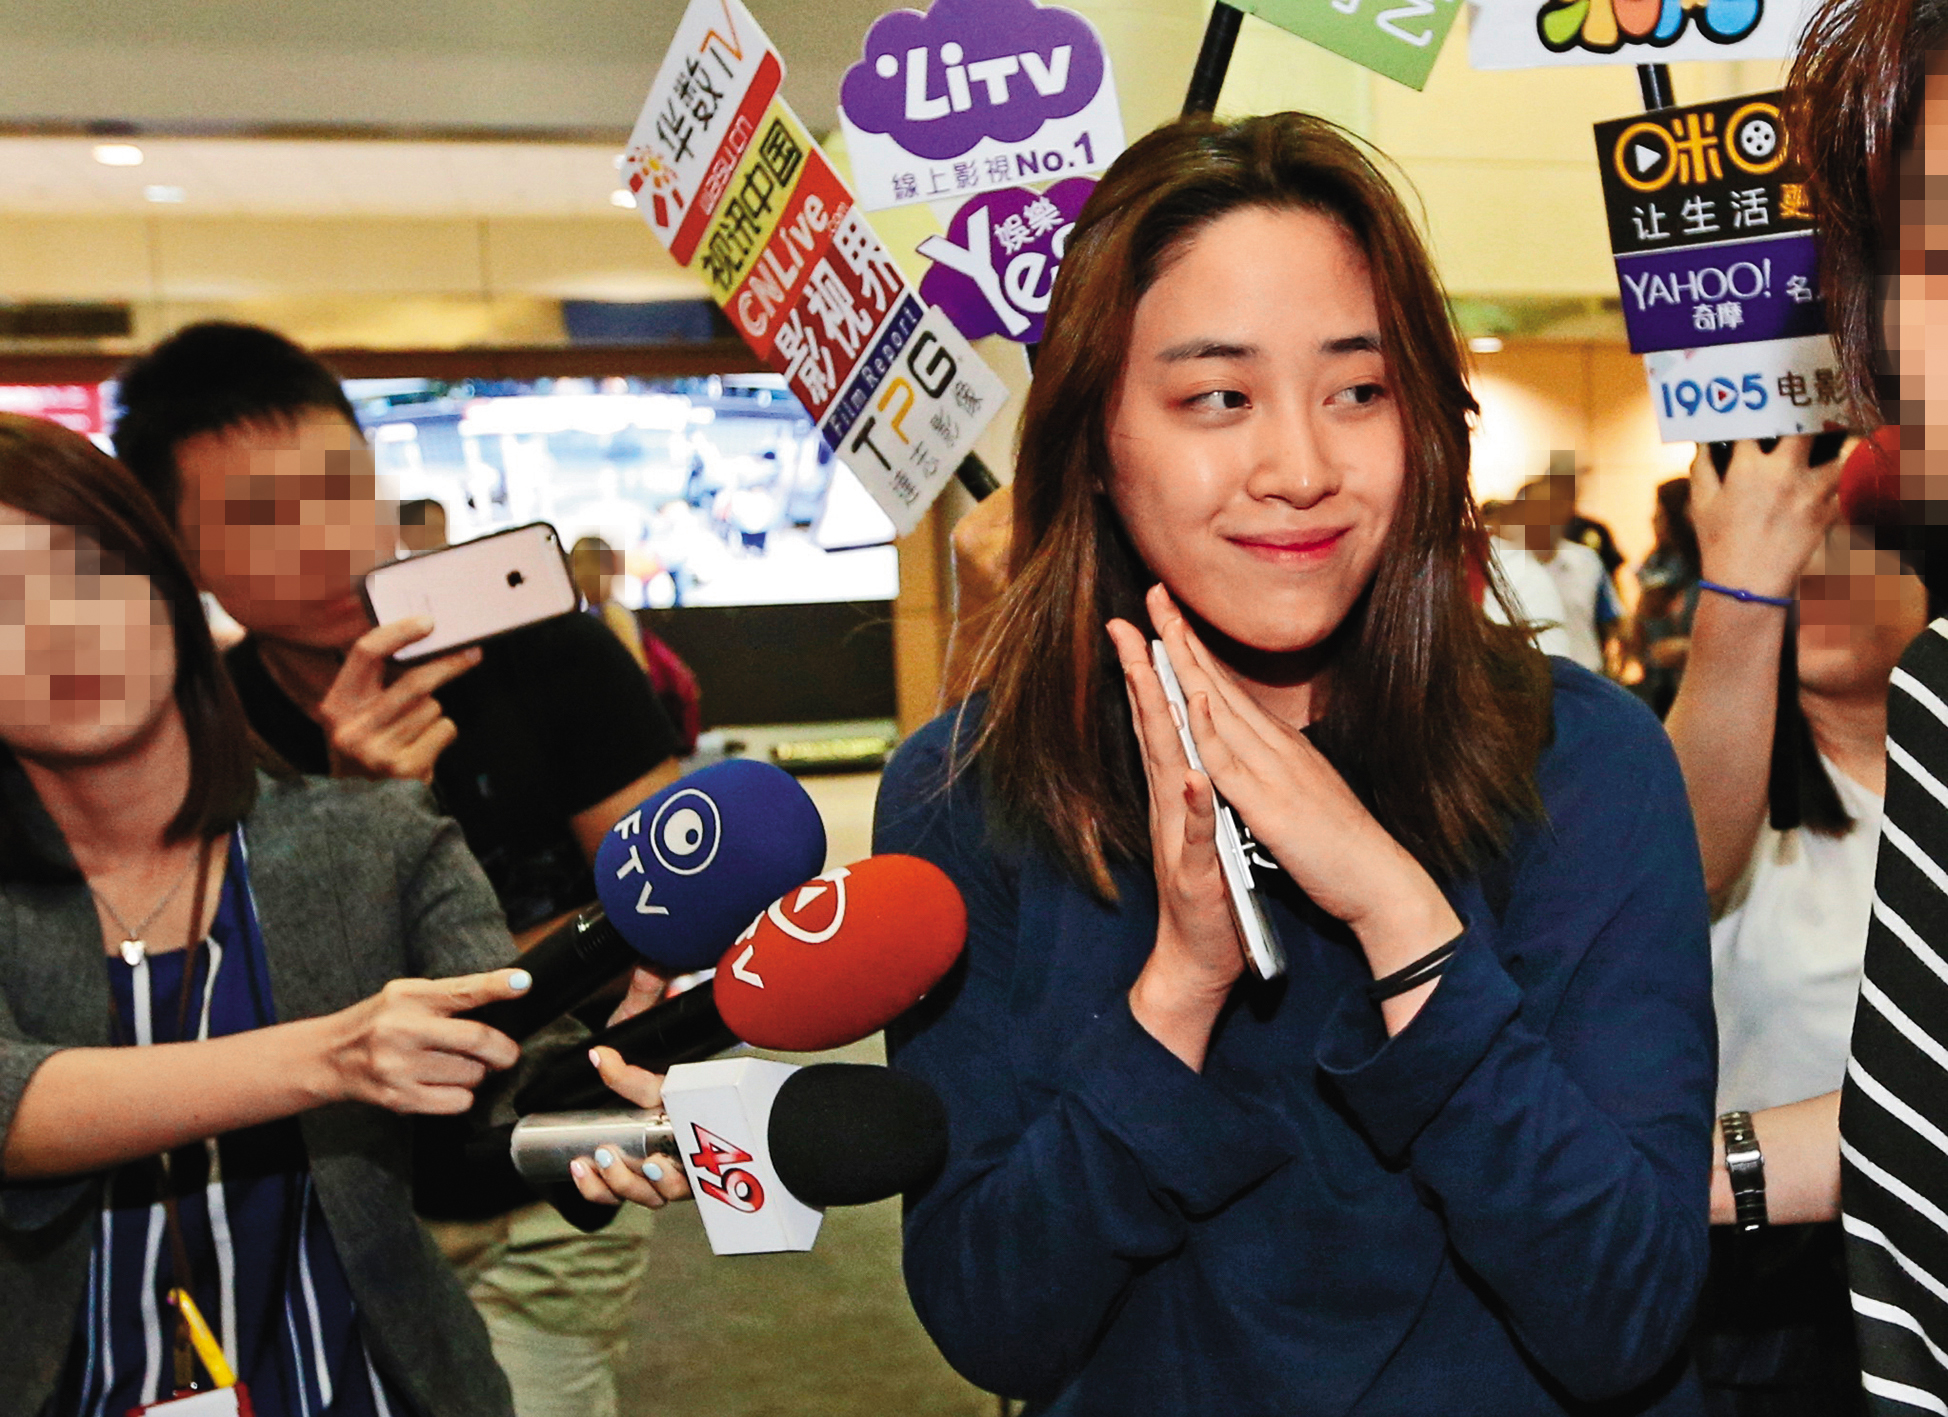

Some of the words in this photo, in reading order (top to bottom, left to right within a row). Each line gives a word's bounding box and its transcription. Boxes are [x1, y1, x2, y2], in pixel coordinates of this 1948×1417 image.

[905, 42, 1072, 121] LiTV
[701, 117, 803, 292] 视讯中国
[773, 207, 904, 405] 影视界
[1623, 257, 1772, 312] YAHOO!
[1691, 300, 1745, 332] 奇摩
[833, 391, 868, 437] Film
[860, 307, 919, 390] Report
[851, 331, 958, 471] TPG
[1661, 373, 1768, 419] 1905
[614, 810, 669, 915] FTV
[690, 1122, 766, 1214] 49
